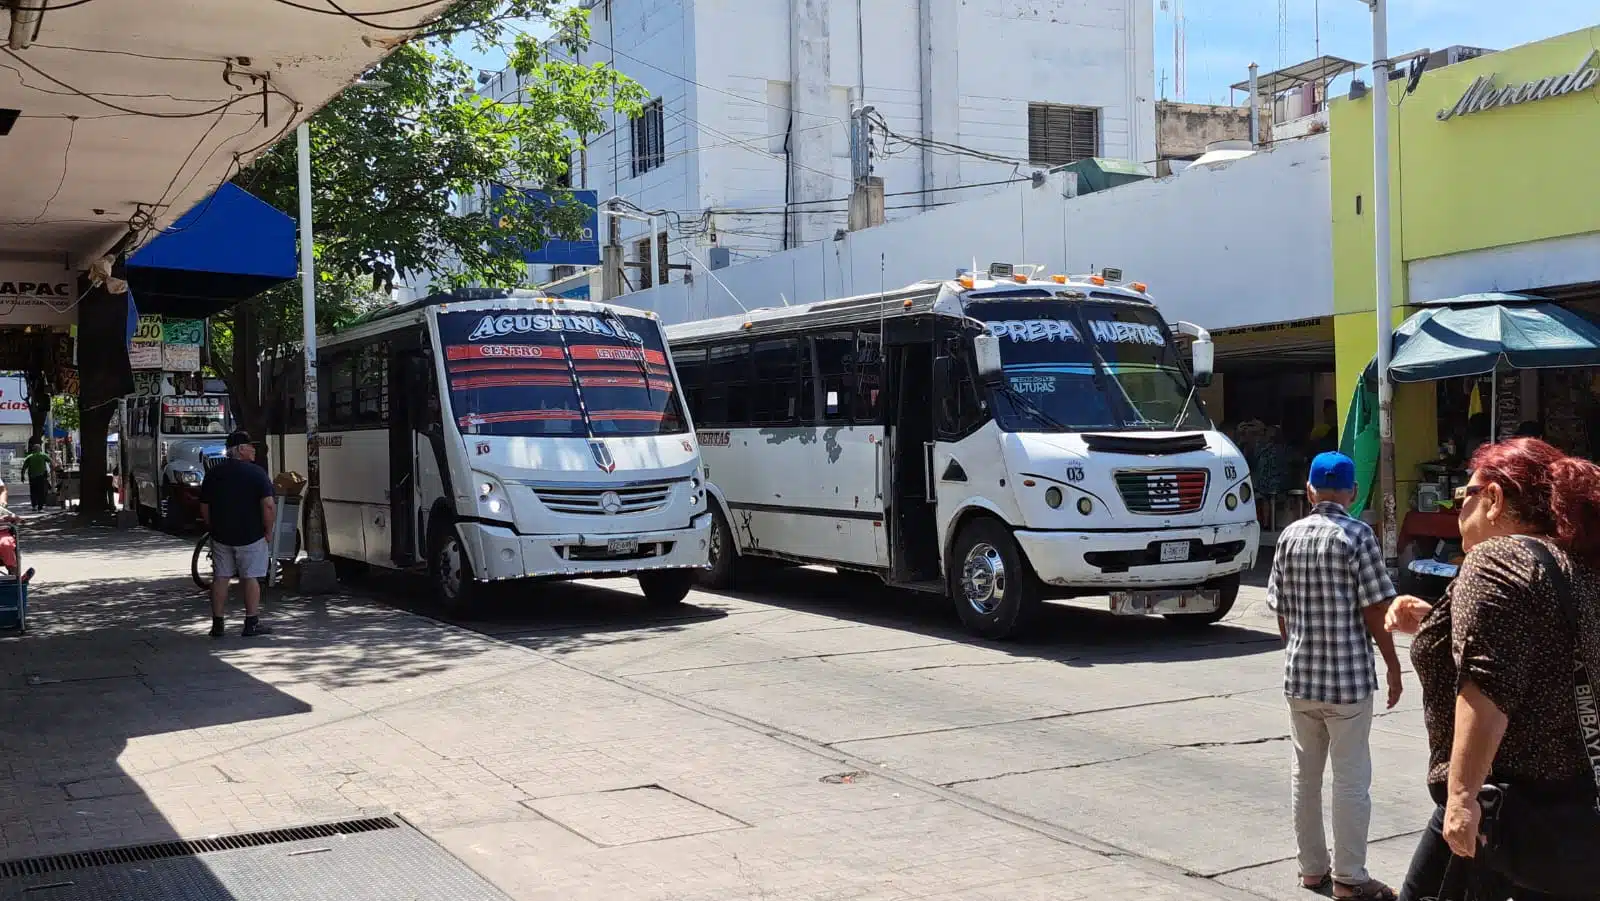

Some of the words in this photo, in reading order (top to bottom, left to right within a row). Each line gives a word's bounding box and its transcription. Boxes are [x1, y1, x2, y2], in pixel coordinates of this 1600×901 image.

[1436, 49, 1600, 122] Mercado
[469, 315, 614, 341] AGUSTINA
[986, 320, 1083, 343] PREPA
[1087, 320, 1167, 347] HUERTAS
[480, 345, 542, 357] CENTRO
[1012, 382, 1056, 393] ALTURAS
[1066, 467, 1085, 482] 03
